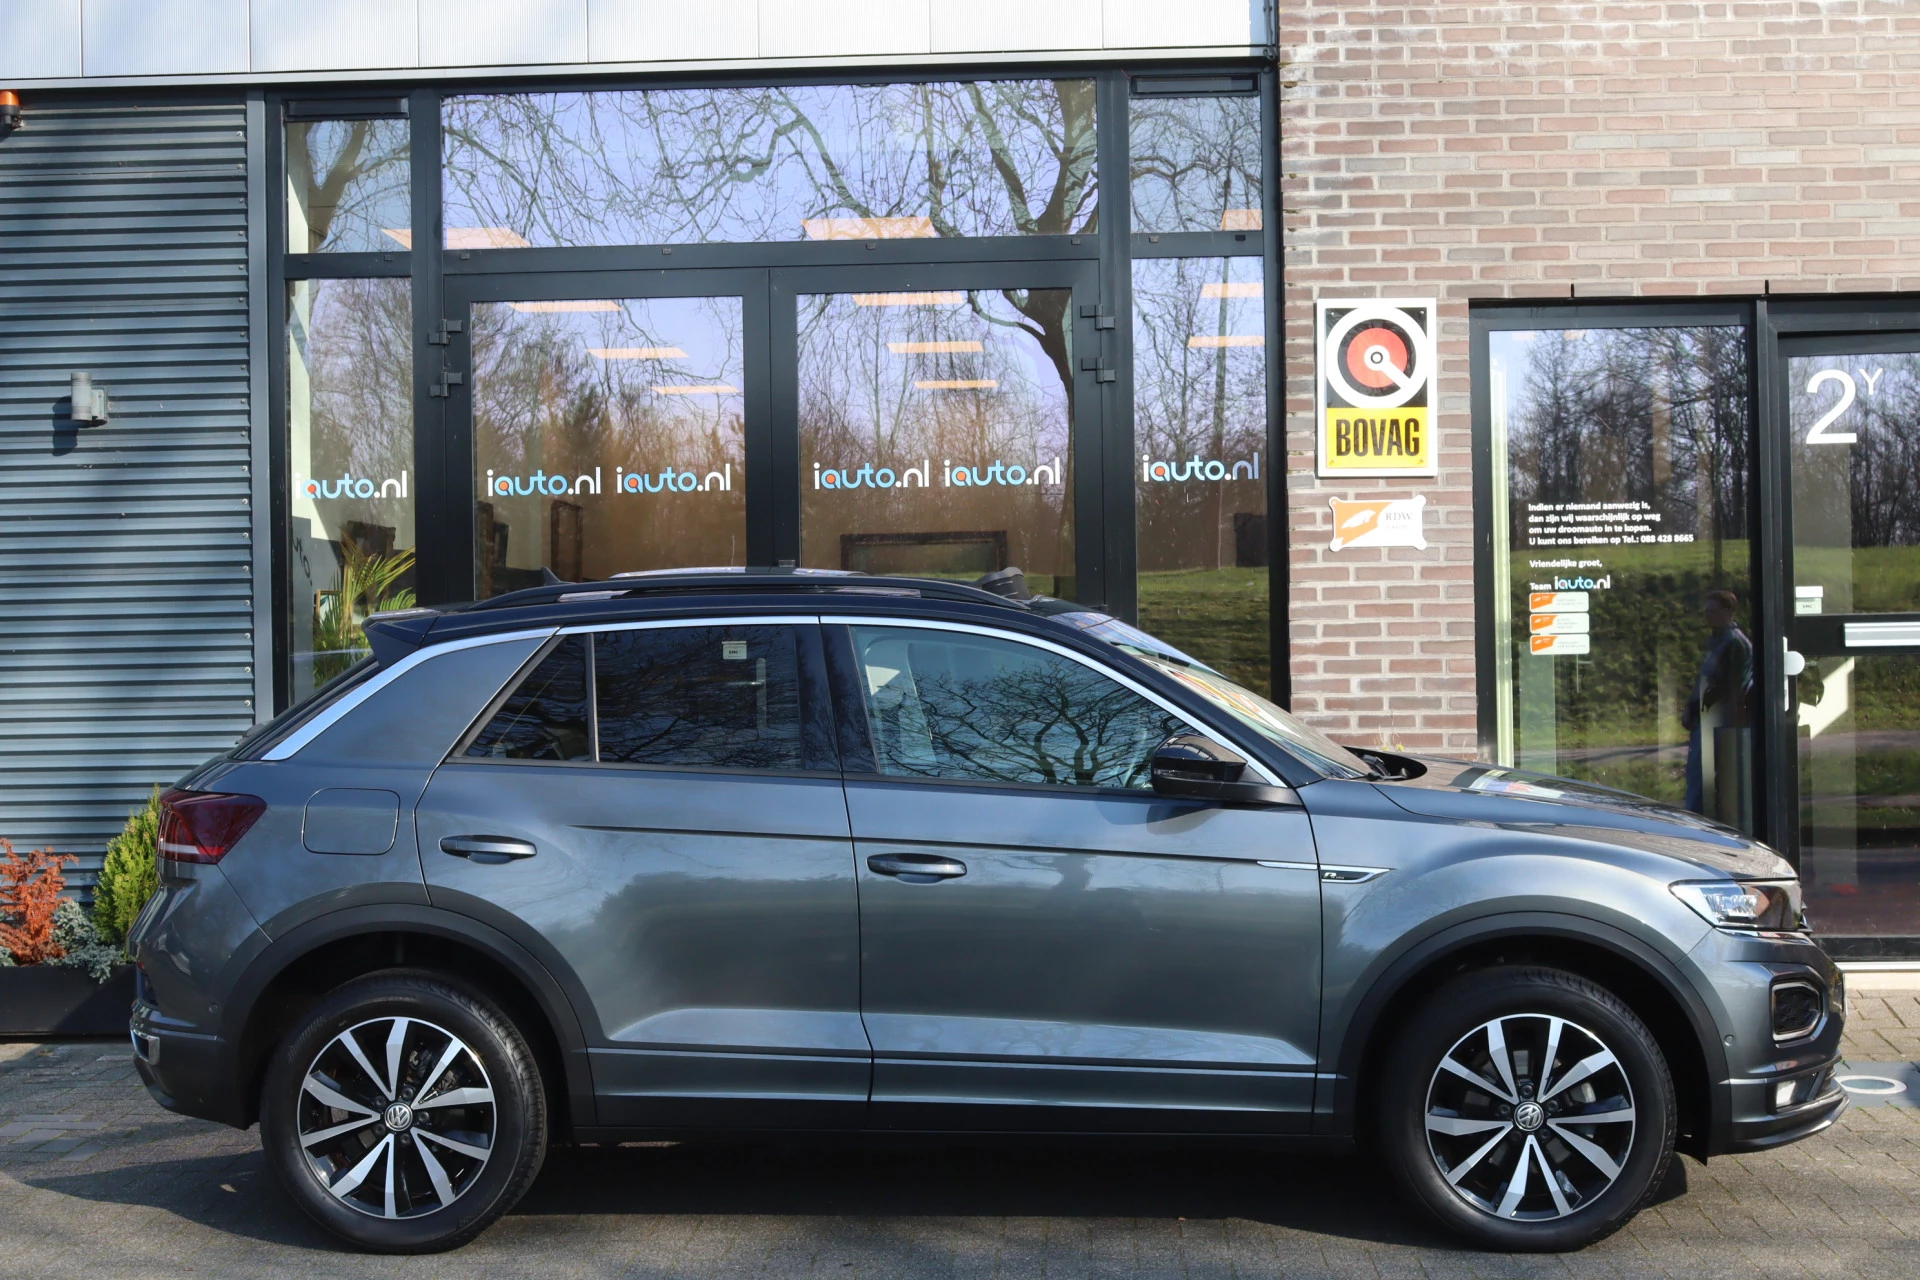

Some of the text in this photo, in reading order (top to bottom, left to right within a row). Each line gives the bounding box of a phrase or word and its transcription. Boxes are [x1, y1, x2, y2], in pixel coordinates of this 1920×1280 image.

[1335, 417, 1420, 457] BOVAG
[813, 456, 1061, 490] iauto.nl iauto.nl
[1142, 452, 1259, 482] iauto.nl
[294, 470, 408, 499] iauto.nl
[486, 463, 732, 497] iauto.nl iauto.nl
[1528, 503, 1554, 511] Indien
[1565, 502, 1601, 511] niemand
[1602, 501, 1640, 510] aanwezig
[1641, 501, 1651, 510] is,
[1384, 511, 1413, 520] RDW
[1528, 513, 1661, 524] dan zijn wij waarschijnlijk op weg
[1558, 525, 1603, 534] droomauto
[1604, 524, 1613, 532] in
[1624, 524, 1652, 533] kopen.
[1529, 537, 1536, 545] U
[1537, 537, 1556, 545] kunt
[1573, 536, 1608, 545] bereiken
[1610, 537, 1621, 545] op
[1622, 535, 1639, 543] Tel.:
[1640, 535, 1656, 543] 088
[1657, 534, 1673, 543] 428
[1673, 534, 1694, 543] 8665
[1529, 559, 1603, 569] Vriendelijke groet,
[1529, 574, 1611, 591] Team iauto.nl
